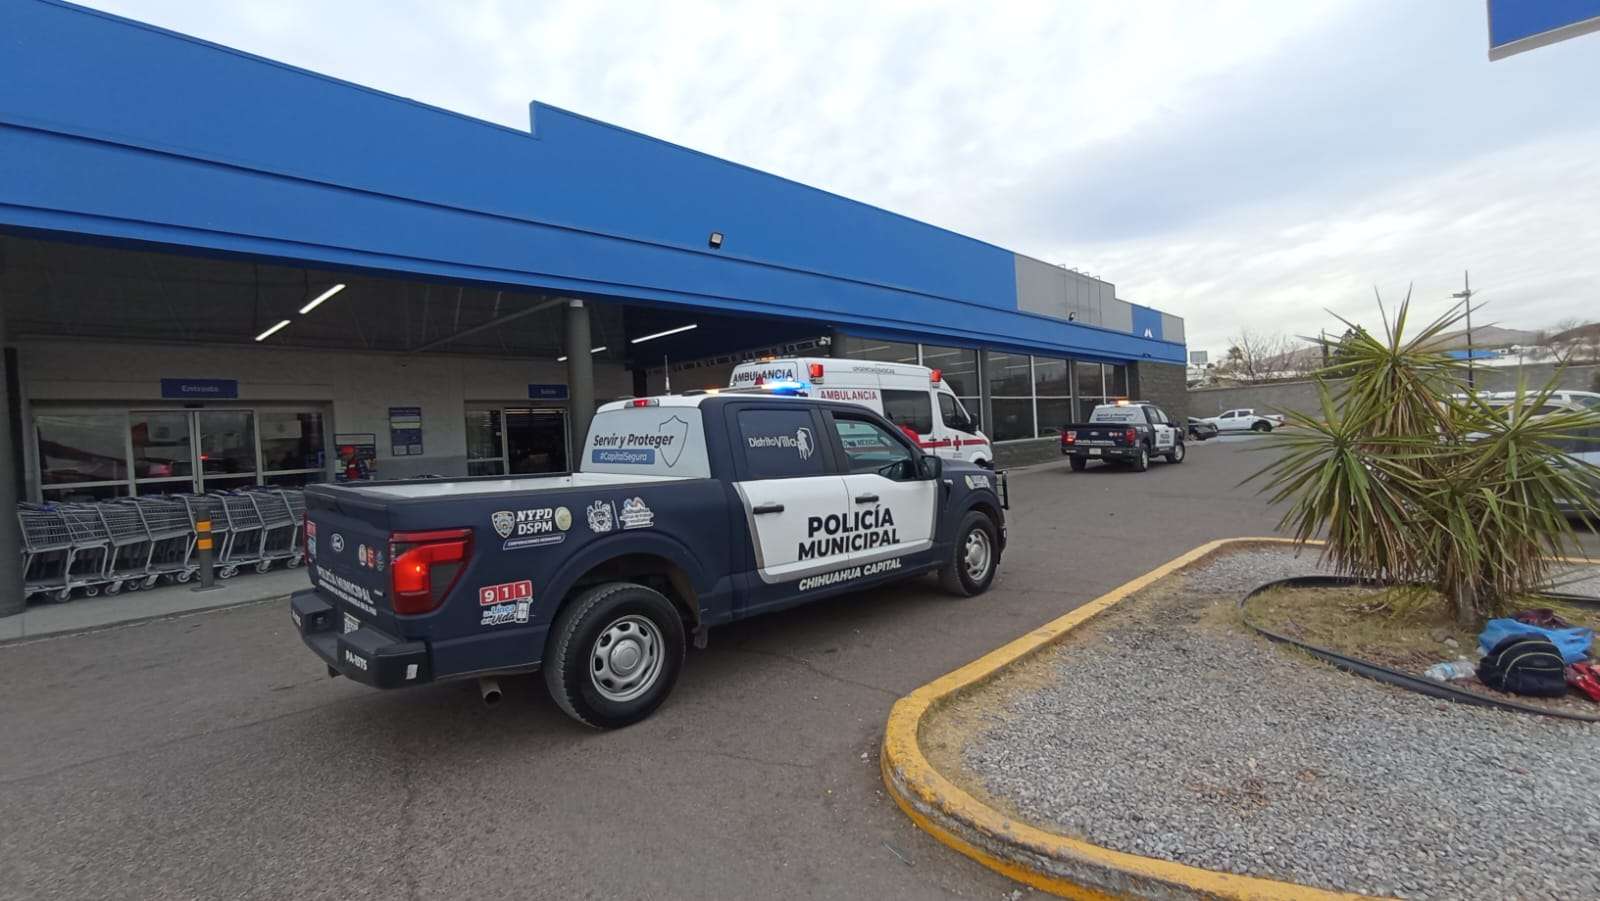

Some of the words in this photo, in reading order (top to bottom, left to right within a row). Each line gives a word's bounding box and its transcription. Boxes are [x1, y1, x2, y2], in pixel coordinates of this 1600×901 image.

[733, 369, 793, 383] AMBULANCIA
[820, 390, 878, 401] AMBULANCIA
[593, 433, 620, 447] Servir
[619, 436, 627, 449] y
[627, 434, 675, 449] Proteger
[515, 508, 553, 522] NYPD
[808, 504, 895, 538] POLICÍA
[518, 521, 553, 535] DSPM
[798, 528, 901, 561] MUNICIPAL
[798, 567, 861, 591] CHIHUAHUA
[863, 558, 902, 576] CAPITAL
[484, 584, 526, 602] 911
